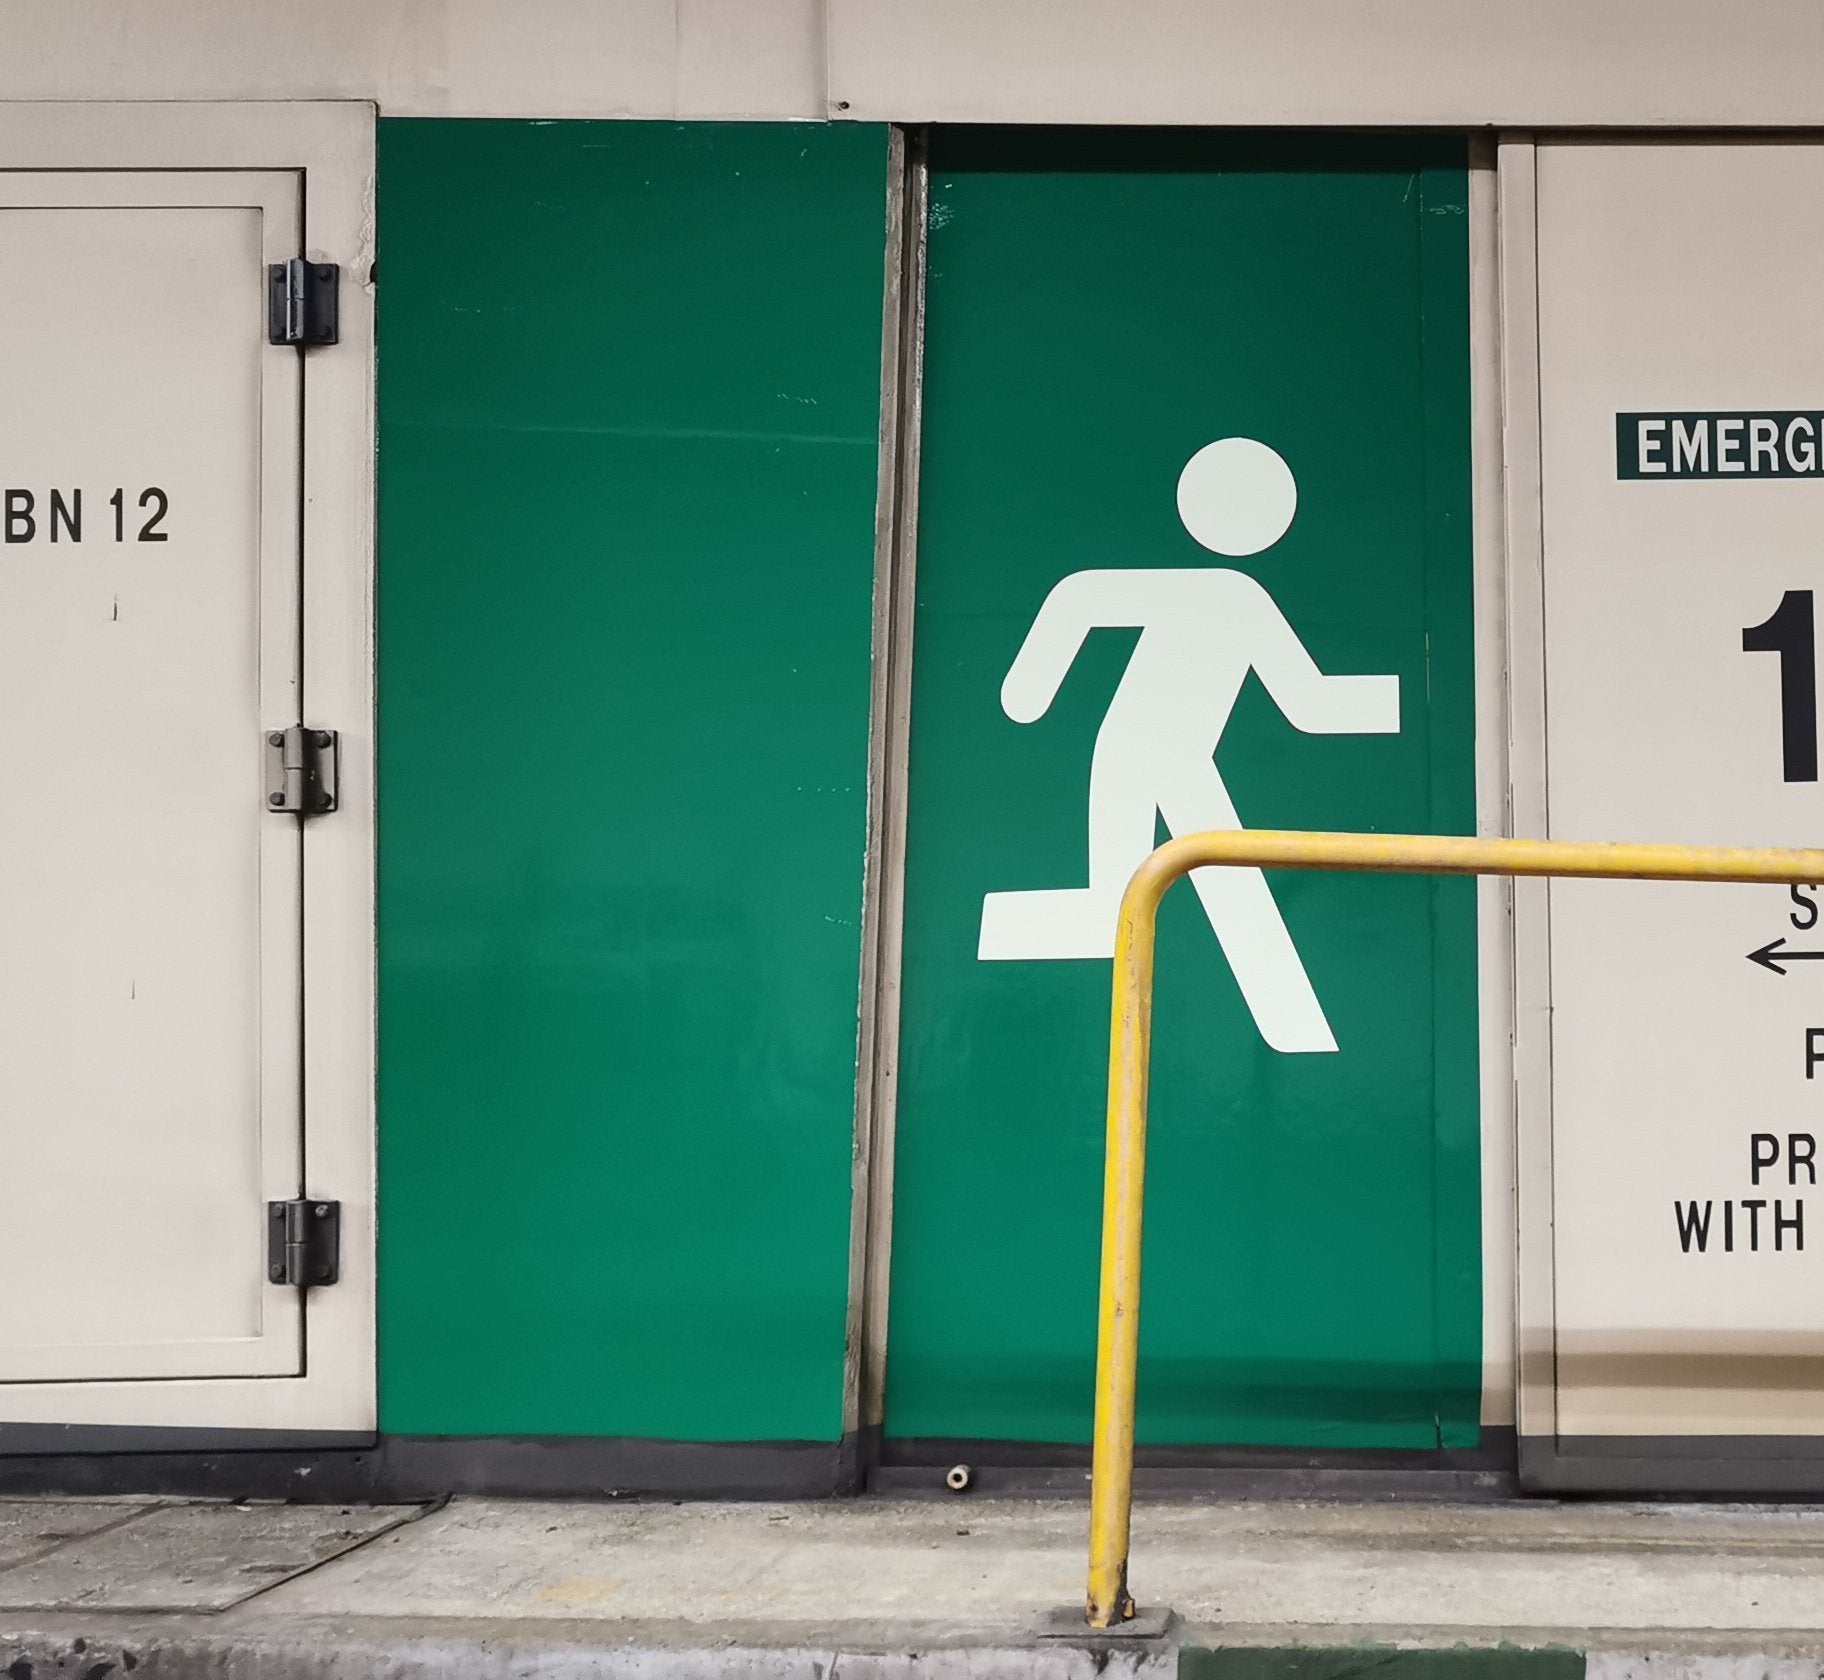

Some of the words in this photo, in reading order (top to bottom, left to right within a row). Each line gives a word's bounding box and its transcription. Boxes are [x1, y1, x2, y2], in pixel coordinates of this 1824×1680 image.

[5, 489, 82, 543] BN
[109, 487, 169, 542] 12
[1674, 1199, 1805, 1253] WITH
